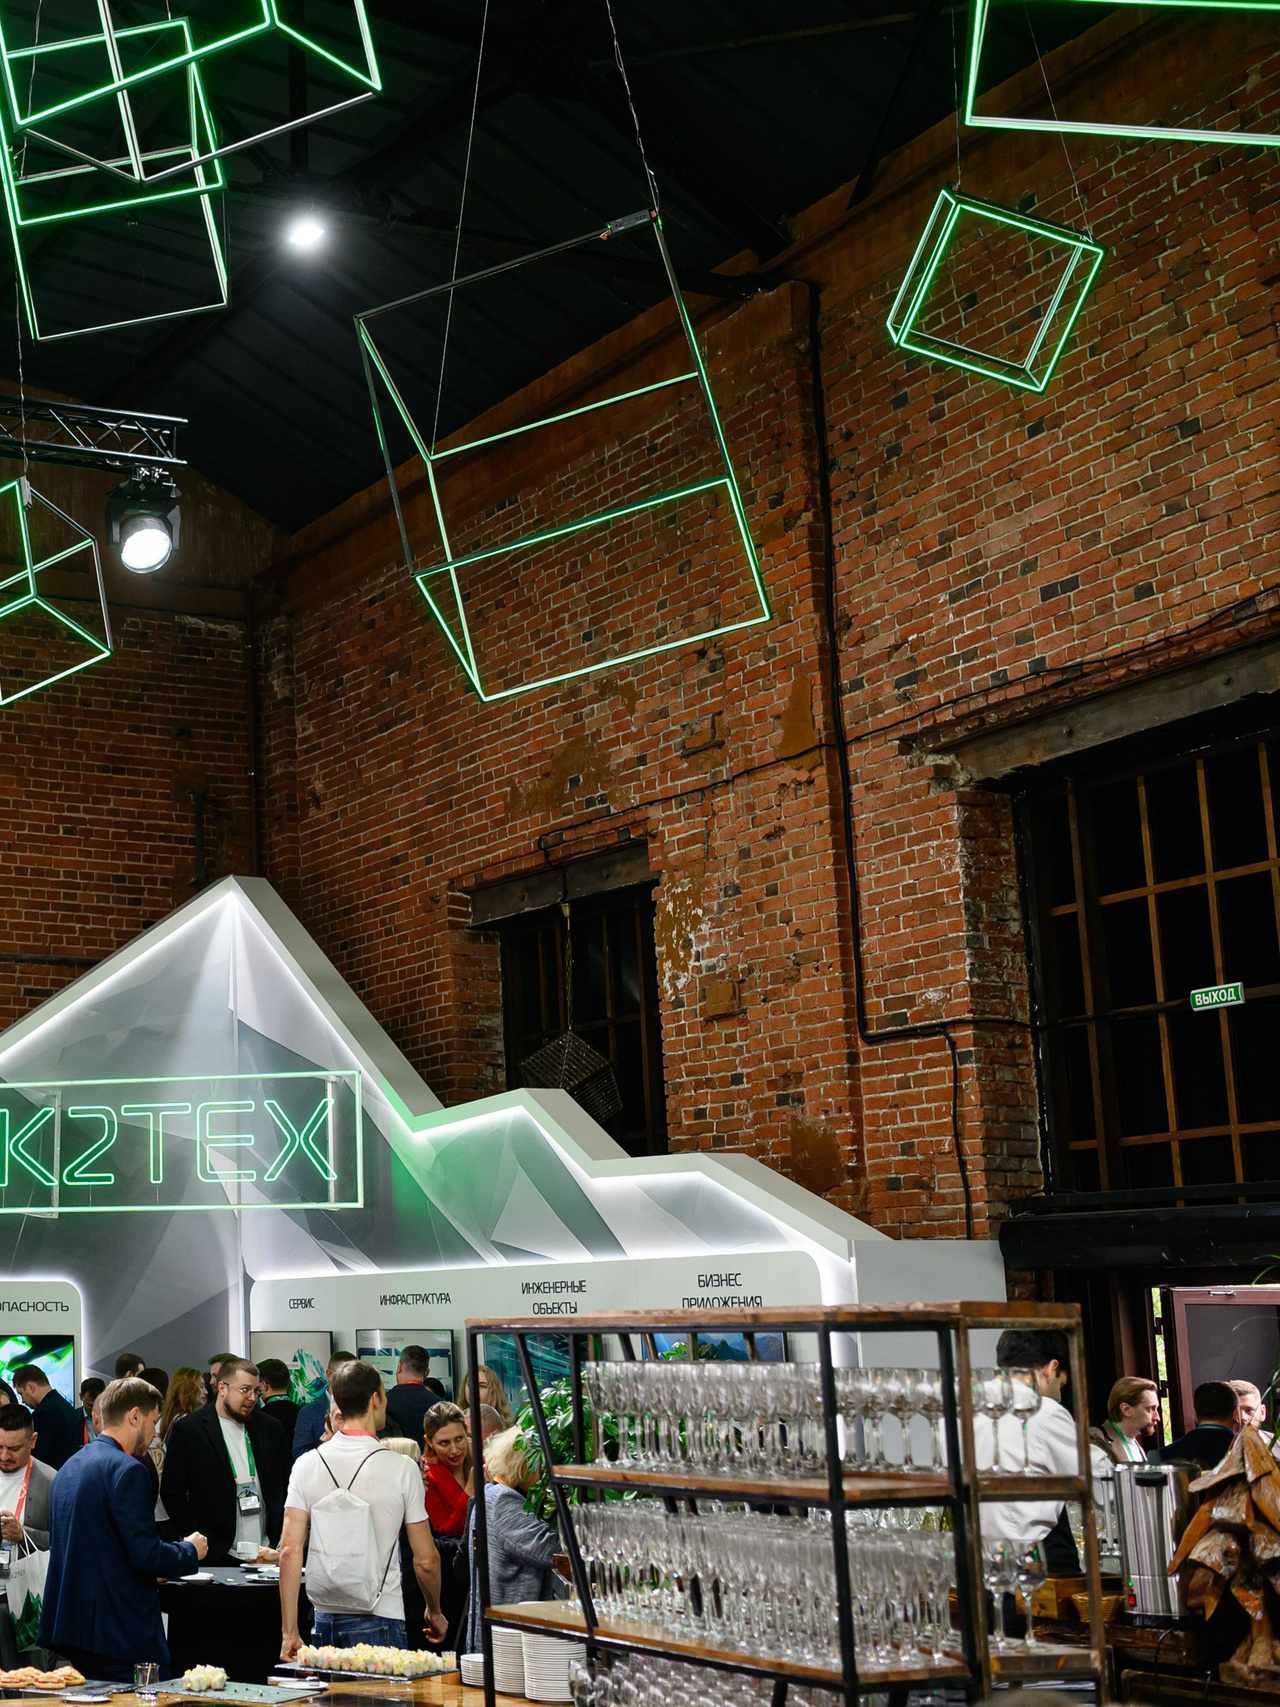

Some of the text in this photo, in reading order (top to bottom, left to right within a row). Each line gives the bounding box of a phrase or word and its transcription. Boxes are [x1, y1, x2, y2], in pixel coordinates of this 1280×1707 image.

[1195, 988, 1237, 1006] ВЫХОД
[521, 1280, 587, 1294] ИНЖЕНЕРНЫЕ
[697, 1272, 742, 1288] БИЗНЕС
[288, 1297, 315, 1309] СЕРВИС
[379, 1293, 451, 1306] ИНФРАСТРУКТУРА
[532, 1301, 578, 1315] ОБЪЕКТЫ
